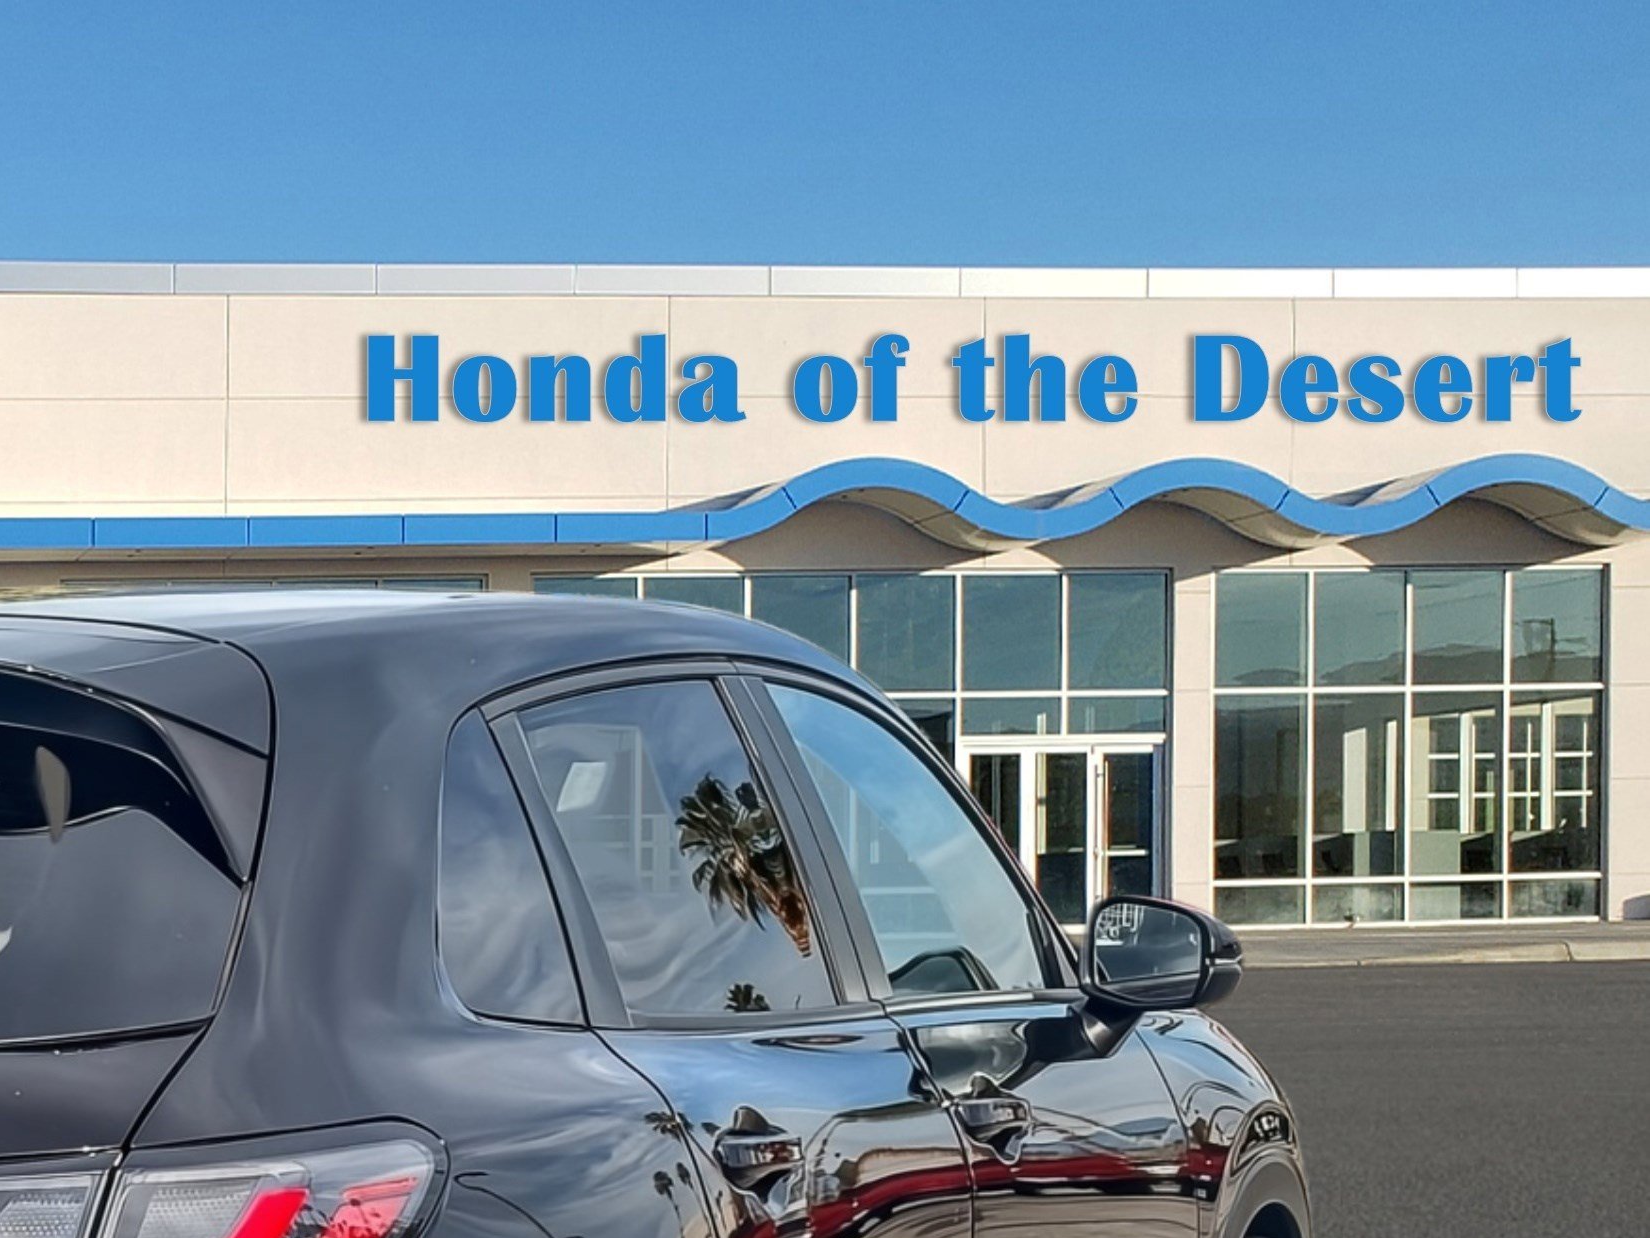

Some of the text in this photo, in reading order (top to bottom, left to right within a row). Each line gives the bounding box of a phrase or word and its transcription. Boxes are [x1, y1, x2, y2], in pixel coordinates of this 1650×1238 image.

[365, 332, 1583, 424] Honda of the Desert
